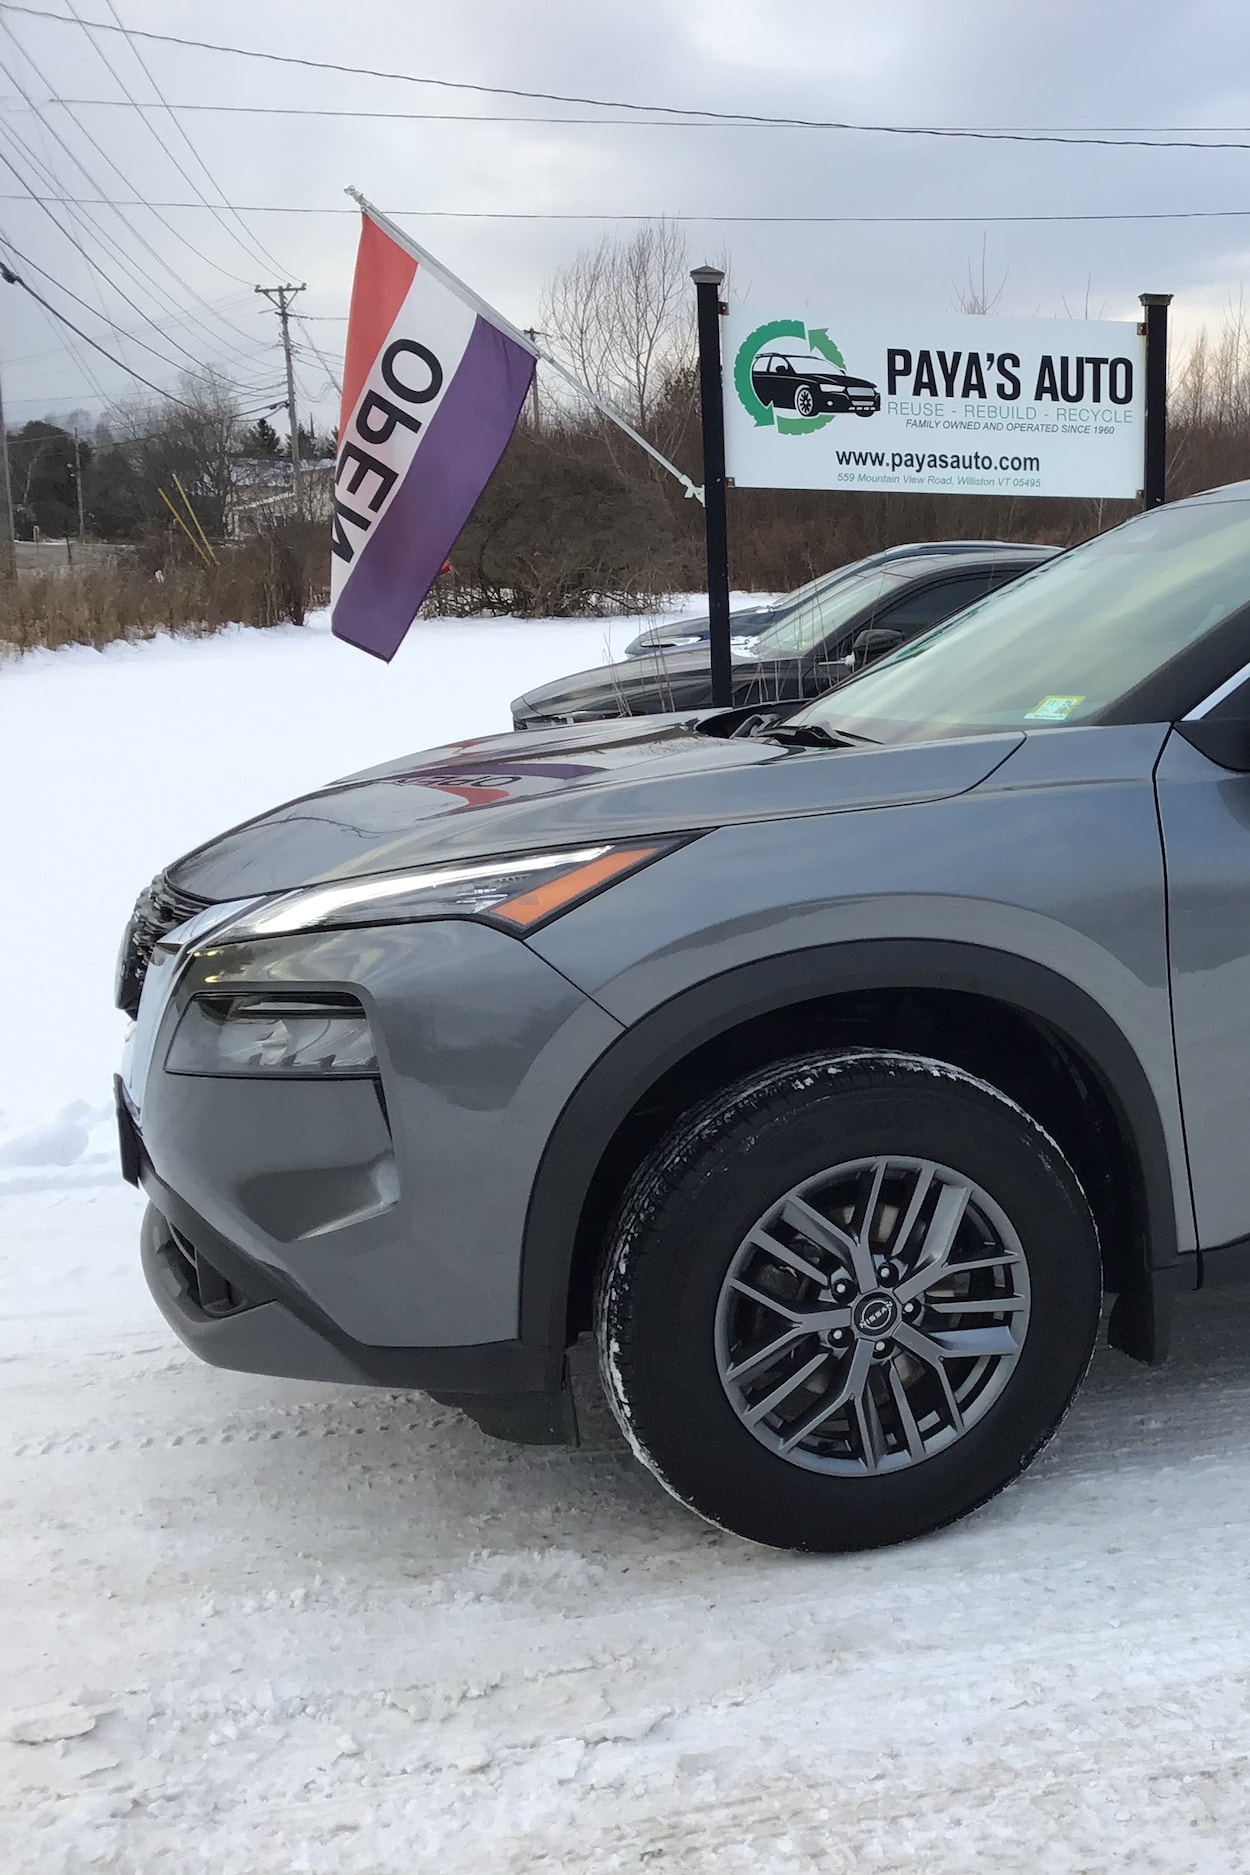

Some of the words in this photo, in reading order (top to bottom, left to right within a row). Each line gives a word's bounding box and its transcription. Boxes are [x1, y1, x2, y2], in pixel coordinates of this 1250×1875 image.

[887, 348, 1021, 401] PAYA'S
[1034, 355, 1133, 405] AUTO
[887, 401, 945, 417] REUSE
[964, 404, 1037, 420] REBUILD
[1056, 407, 1133, 424] RECYCLE
[905, 418, 941, 429] FAMILY
[942, 420, 981, 431] OWNED
[982, 422, 1004, 431] AND
[1005, 422, 1059, 433] OPERATED
[1060, 424, 1091, 434] SINCE
[1093, 425, 1115, 435] 1960
[835, 450, 1040, 474] www.payasauto.com
[837, 472, 855, 482] 559
[857, 473, 900, 483] Mountain
[902, 475, 926, 485] View
[927, 475, 954, 486] Road,
[957, 476, 995, 486] Williston
[998, 477, 1011, 487] VT
[1012, 478, 1041, 488] 05495
[859, 1300, 894, 1329] NISSAN
